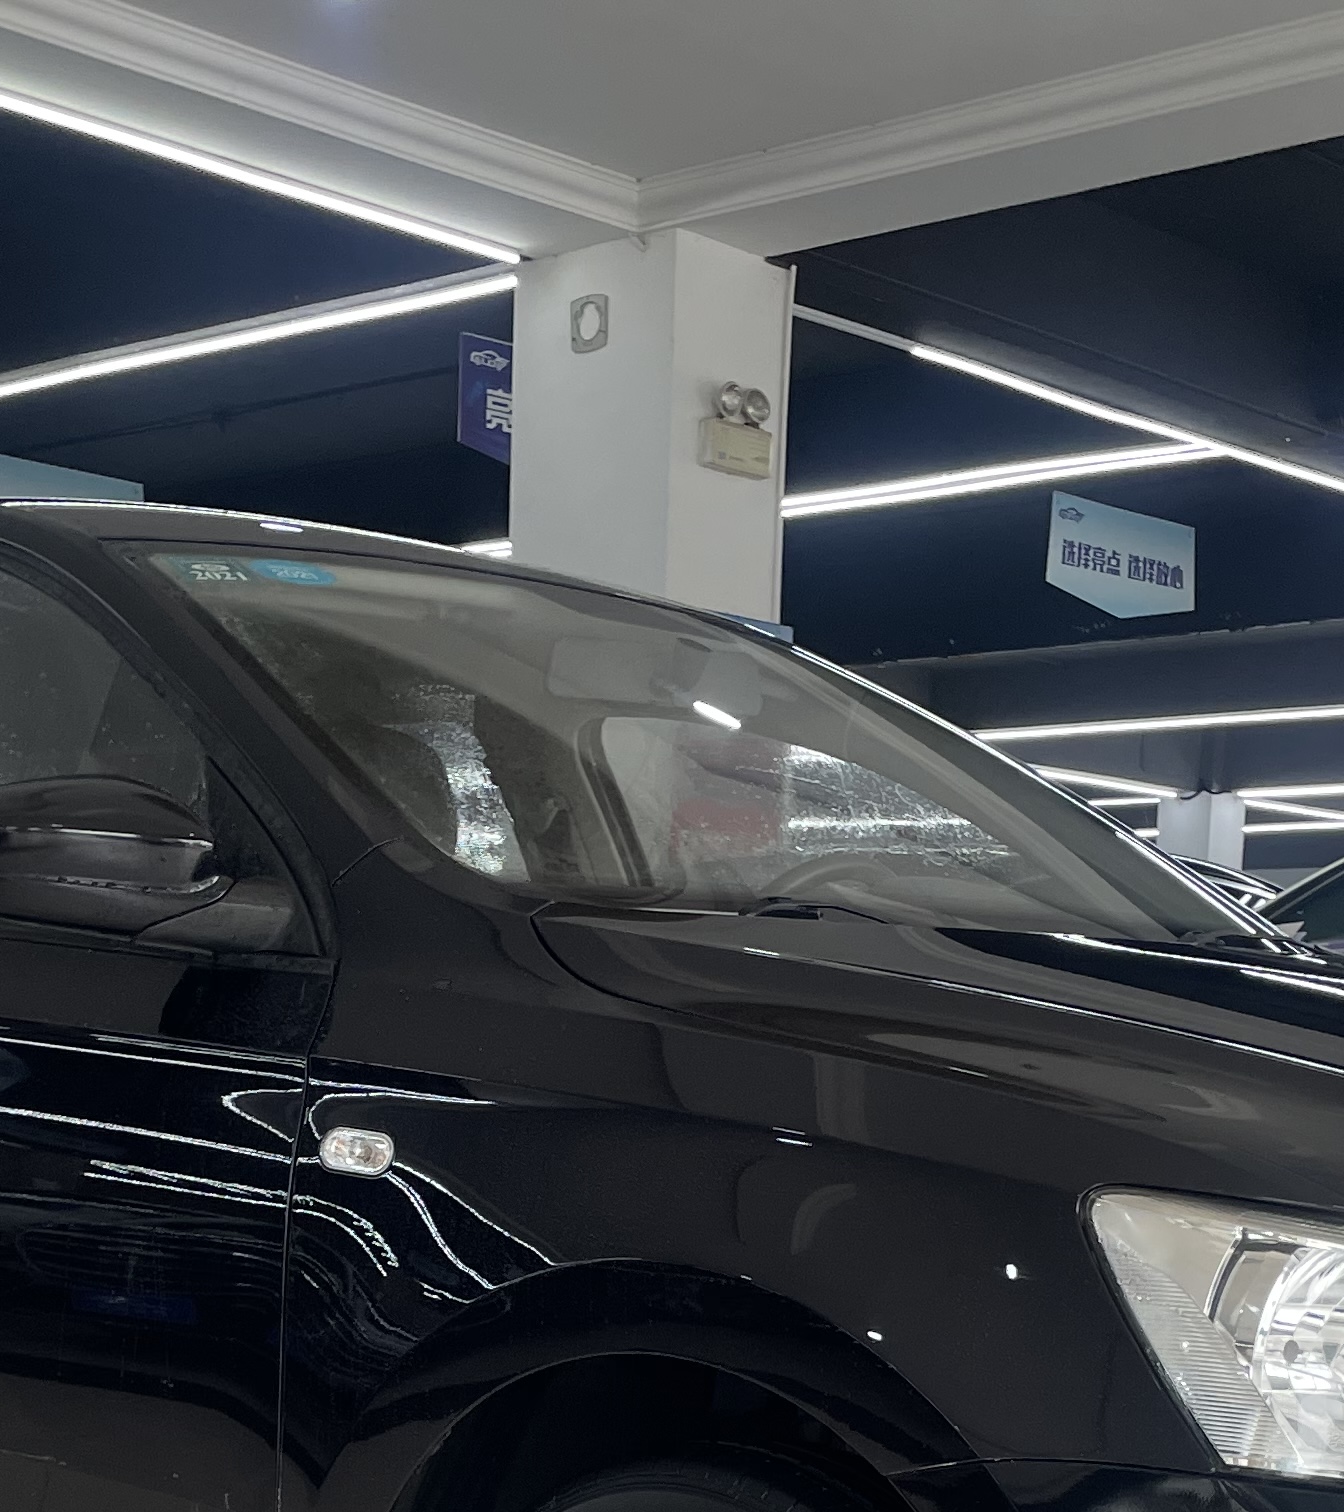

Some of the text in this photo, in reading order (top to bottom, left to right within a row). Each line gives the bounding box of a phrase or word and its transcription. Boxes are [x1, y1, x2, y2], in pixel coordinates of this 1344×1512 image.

[1062, 538, 1121, 576] 选择亮点
[189, 570, 249, 582] 2021
